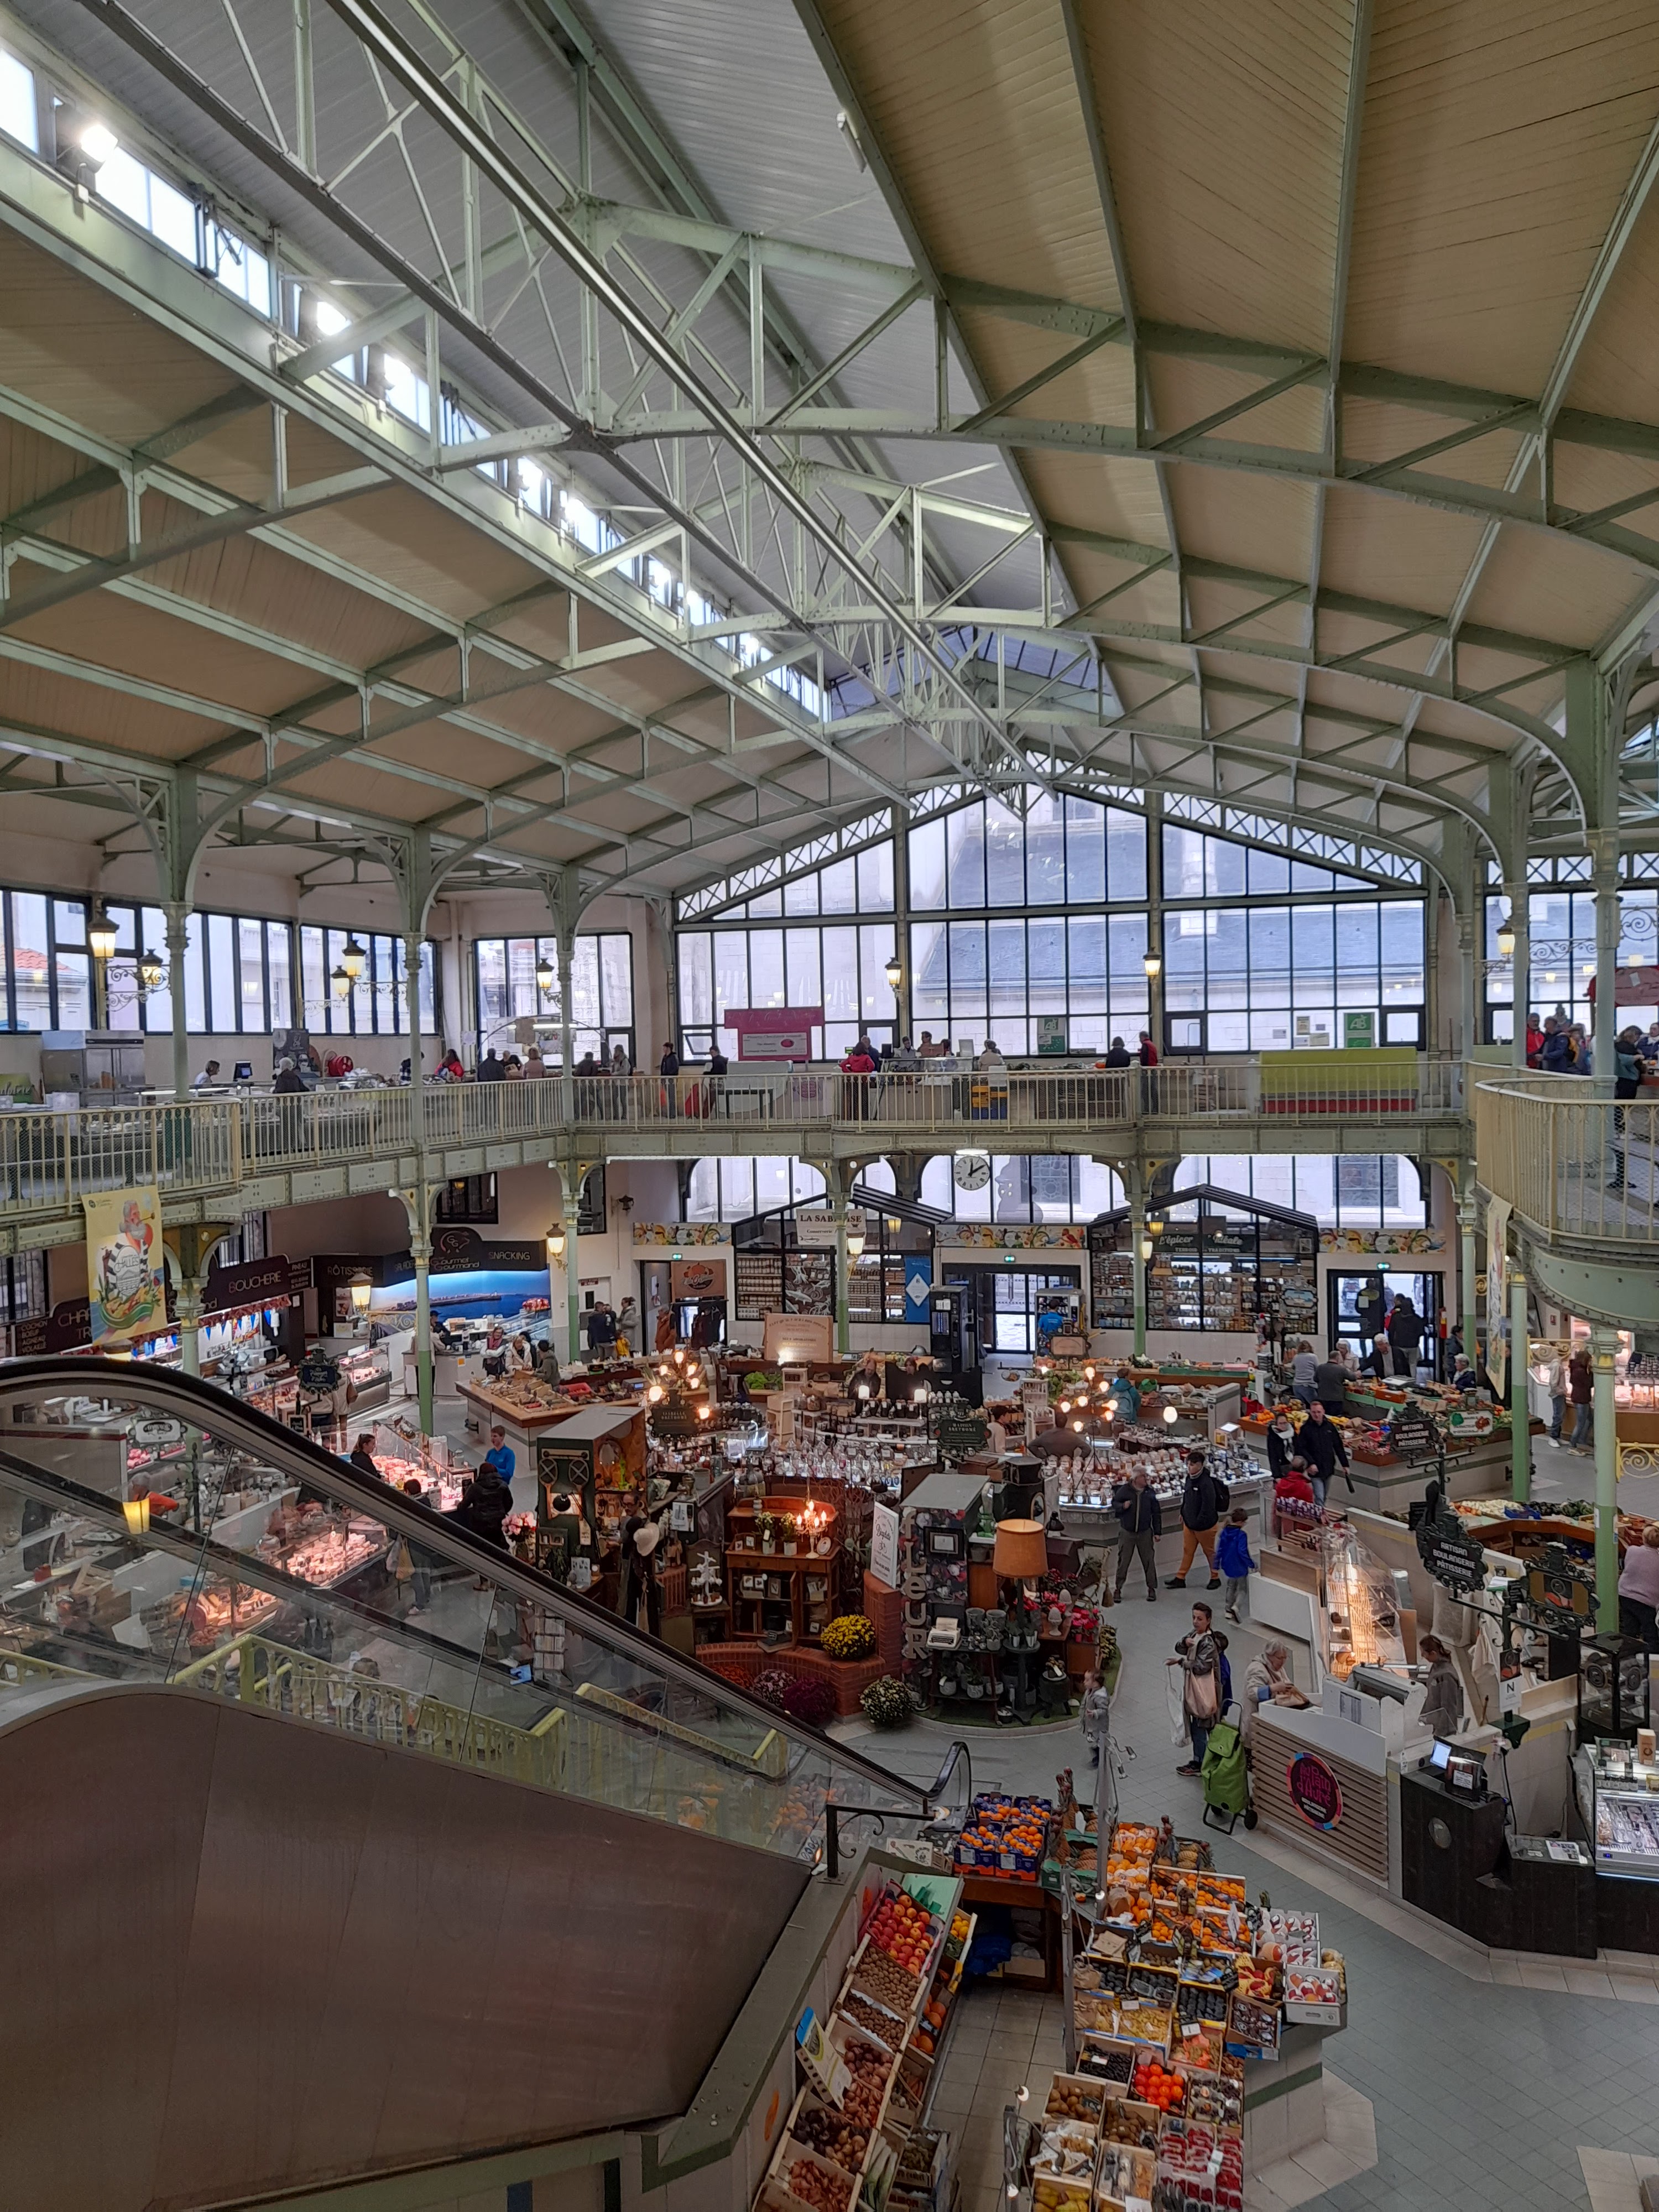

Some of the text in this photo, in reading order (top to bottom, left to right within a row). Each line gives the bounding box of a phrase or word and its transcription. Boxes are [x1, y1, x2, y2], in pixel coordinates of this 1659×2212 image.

[489, 1251, 531, 1260] SNACKING
[228, 1271, 282, 1293] BOUCHERIE
[1395, 1430, 1430, 1439] BOULANGERIE
[1440, 1541, 1468, 1557] ARTISAN
[1432, 1548, 1476, 1569] BOULANGERIE
[1436, 1559, 1473, 1578] PÂTISSERIE
[1507, 1682, 1514, 1693] N
